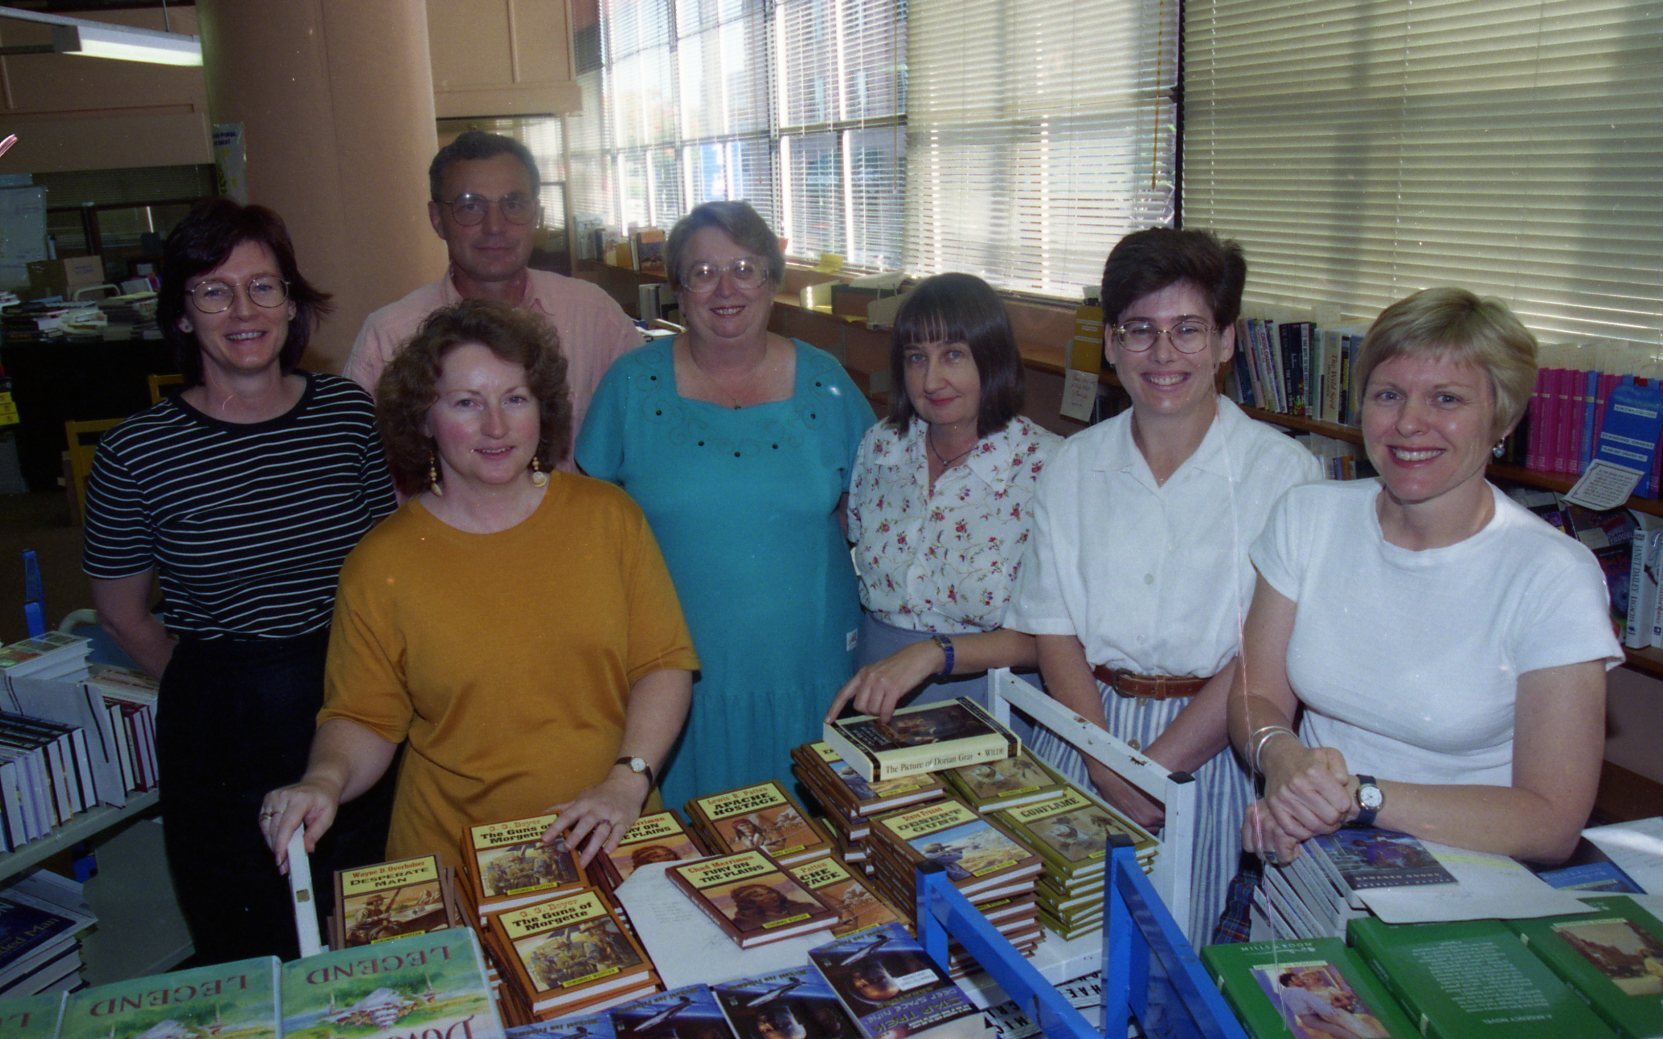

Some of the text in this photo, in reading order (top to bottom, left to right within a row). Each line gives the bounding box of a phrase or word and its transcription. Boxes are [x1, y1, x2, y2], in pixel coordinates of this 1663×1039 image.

[885, 764, 899, 774] The
[900, 761, 923, 772] Picture
[925, 759, 934, 768] of
[934, 755, 957, 767] Dorian
[958, 752, 974, 764] Gray
[713, 796, 779, 816] HOSTAGE
[714, 792, 772, 810] APACHE
[1020, 797, 1081, 819] GUNFLAME
[643, 822, 660, 831] ON
[897, 808, 963, 831] DESERT
[912, 815, 960, 833] GUNS
[480, 829, 505, 840] The
[507, 826, 538, 836] Guns
[489, 830, 545, 845] Morgett
[632, 826, 673, 838] PLAINS
[350, 867, 430, 887] DESPERATE
[699, 864, 766, 884] THE PLAINS
[702, 861, 751, 877] FURY ON
[800, 867, 832, 882] CHE
[375, 877, 408, 888] MAN
[512, 901, 594, 928] The Guns of
[524, 910, 589, 932] Morgette
[306, 946, 452, 985] LEGEND
[89, 974, 248, 1017] LEGEND
[922, 996, 965, 1016] STAR
[872, 1012, 919, 1034] TREK
